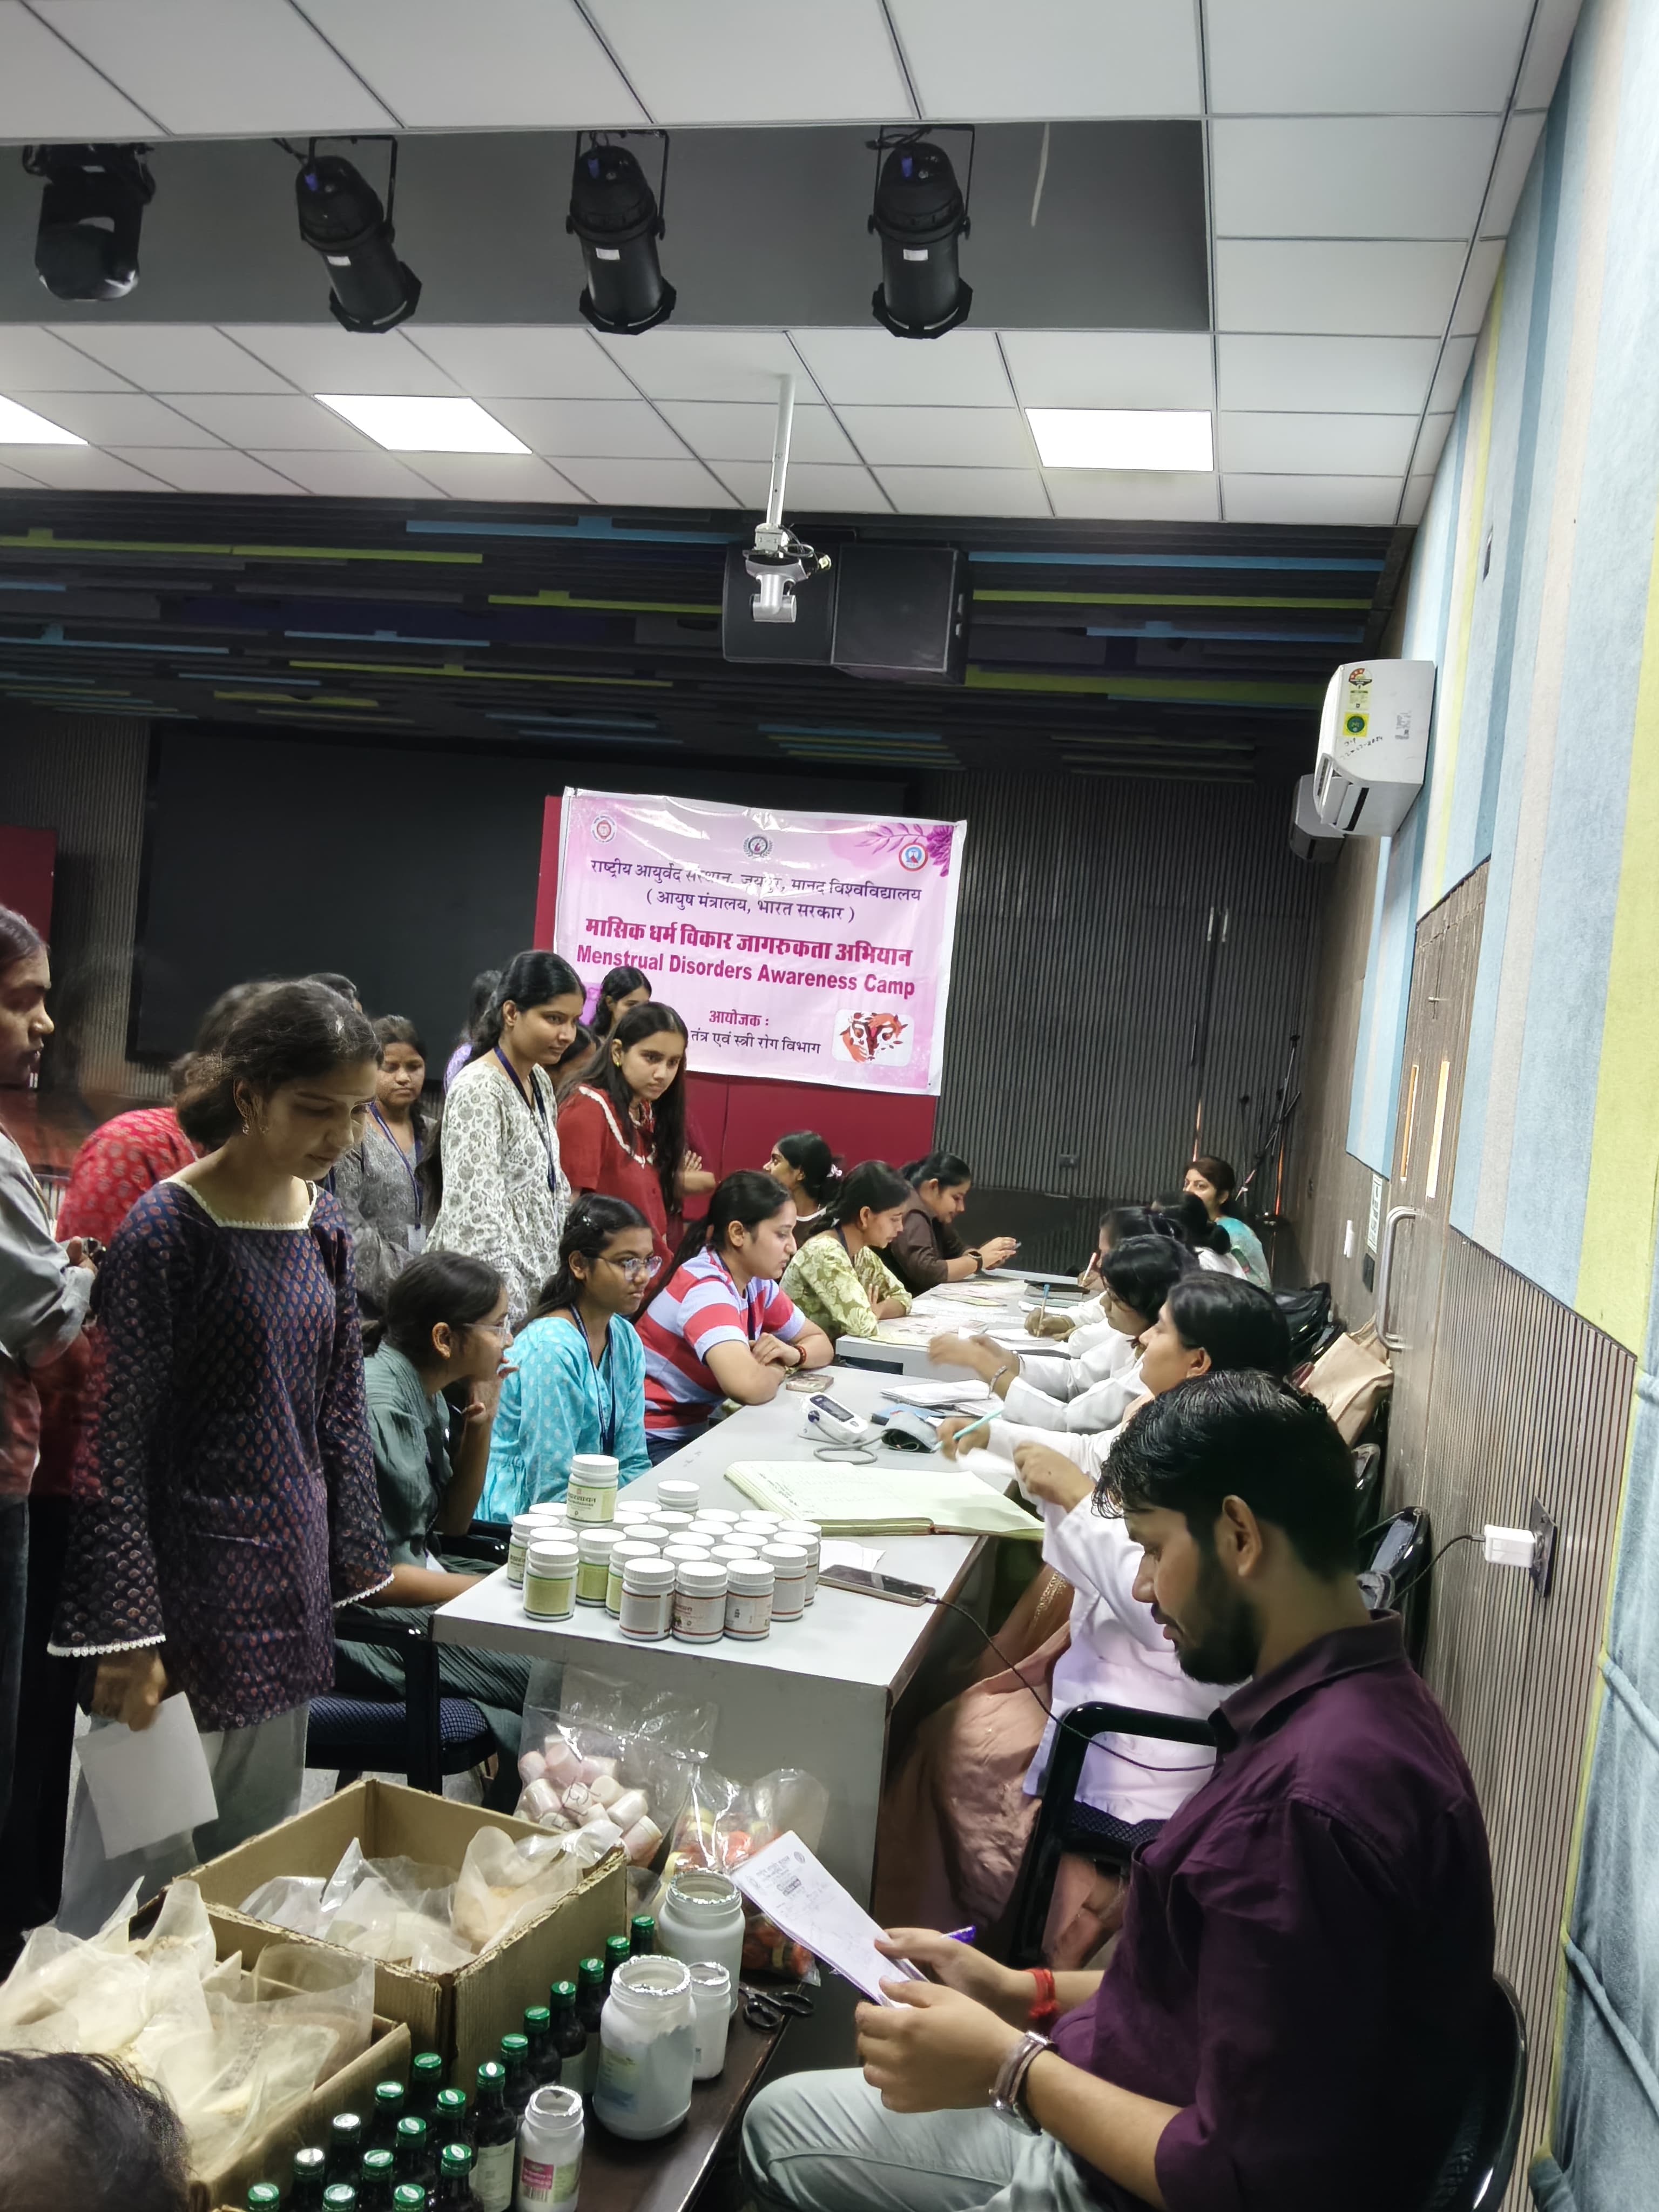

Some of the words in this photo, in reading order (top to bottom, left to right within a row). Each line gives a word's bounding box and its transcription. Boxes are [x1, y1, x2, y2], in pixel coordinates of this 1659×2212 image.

[635, 862, 683, 884] आयुर्वेद
[791, 879, 826, 895] मानद
[830, 878, 922, 901] विश्वविद्यालय
[657, 891, 695, 911] आयुष
[698, 892, 751, 914] मंत्रालय,
[757, 900, 793, 916] भारत
[797, 903, 845, 920] सरकार
[585, 916, 646, 940] मासिक
[650, 921, 678, 944] धर्म
[680, 923, 733, 950] विकार
[835, 940, 914, 967] अभियान
[576, 945, 664, 971] Menstrual
[669, 954, 753, 981] Disorders
[757, 964, 858, 990] Awareness
[864, 974, 915, 1000] Camp
[709, 1009, 763, 1027] आयोजक
[690, 1027, 710, 1042] तंत्र
[712, 1031, 732, 1048] एवं
[734, 1033, 755, 1048] स्त्री
[757, 1034, 779, 1050] रोग
[781, 1036, 821, 1054] विभाग
